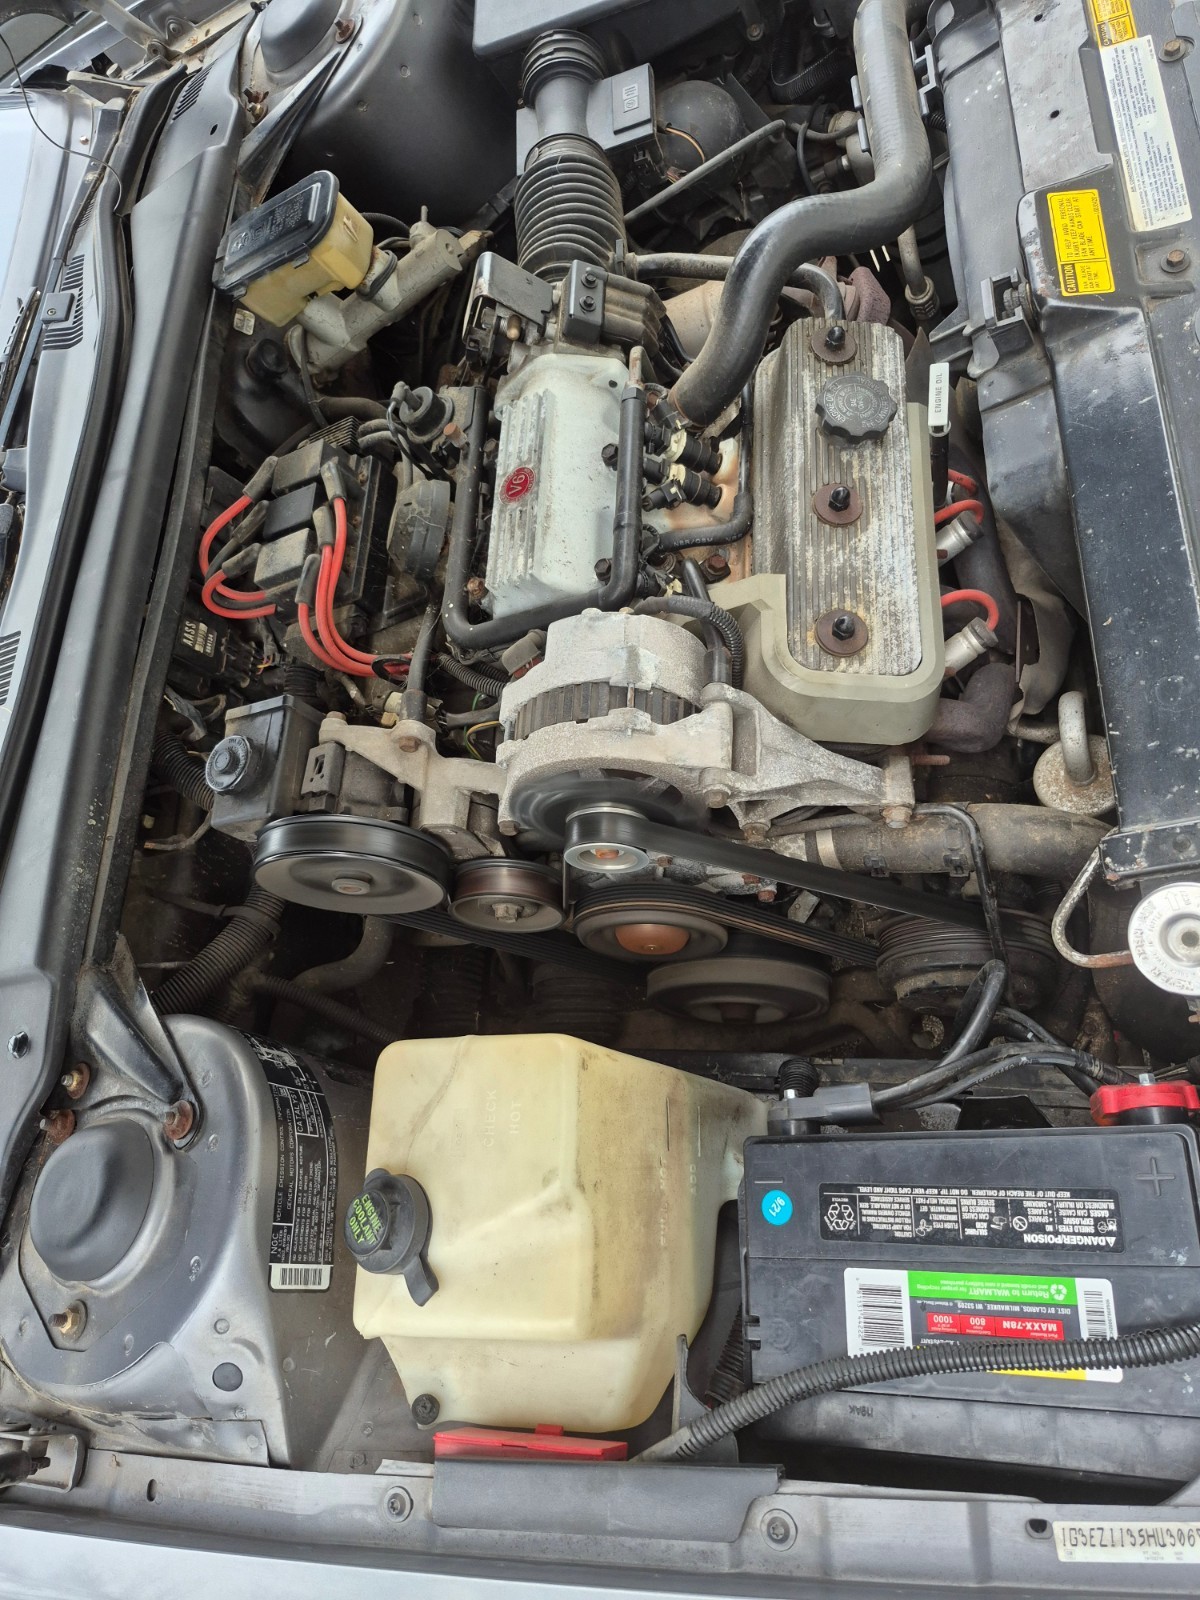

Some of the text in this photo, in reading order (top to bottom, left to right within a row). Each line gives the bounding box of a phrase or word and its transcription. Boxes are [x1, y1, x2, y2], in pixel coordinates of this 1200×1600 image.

[1057, 197, 1066, 219] PERSONAL
[1073, 204, 1081, 218] START
[1067, 212, 1075, 227] HANDS
[1072, 241, 1080, 257] INJURY
[1087, 247, 1095, 256] ANY
[1063, 264, 1076, 292] CAUTION
[826, 403, 846, 423] ENGINE
[508, 474, 525, 494] V6
[182, 620, 196, 646] AASS
[289, 1088, 303, 1132] CATALYST
[508, 1099, 522, 1134] HOT
[286, 1108, 294, 1148] CORPORATION
[767, 1195, 785, 1217] 9/21
[1027, 1207, 1048, 1215] FLAMES
[1084, 1201, 1114, 1209] BLINDNESS
[361, 1193, 383, 1233] ENGINE
[353, 1198, 376, 1244] COOLANT
[1058, 1224, 1094, 1233] SHIELD EYES
[1062, 1217, 1093, 1225] EXPLOSIVE
[349, 1216, 364, 1243] ONLY
[270, 1233, 278, 1253] NGC
[1022, 1233, 1105, 1245] DANGER/POISON
[968, 1286, 1010, 1296] WALMART
[1011, 1288, 1019, 1296] to
[1021, 1289, 1049, 1298] Return
[984, 1303, 1019, 1311] MILWAUKEE,
[933, 1314, 952, 1323] 1000
[969, 1317, 985, 1325] 800
[1002, 1320, 1057, 1330] MAXX-78N
